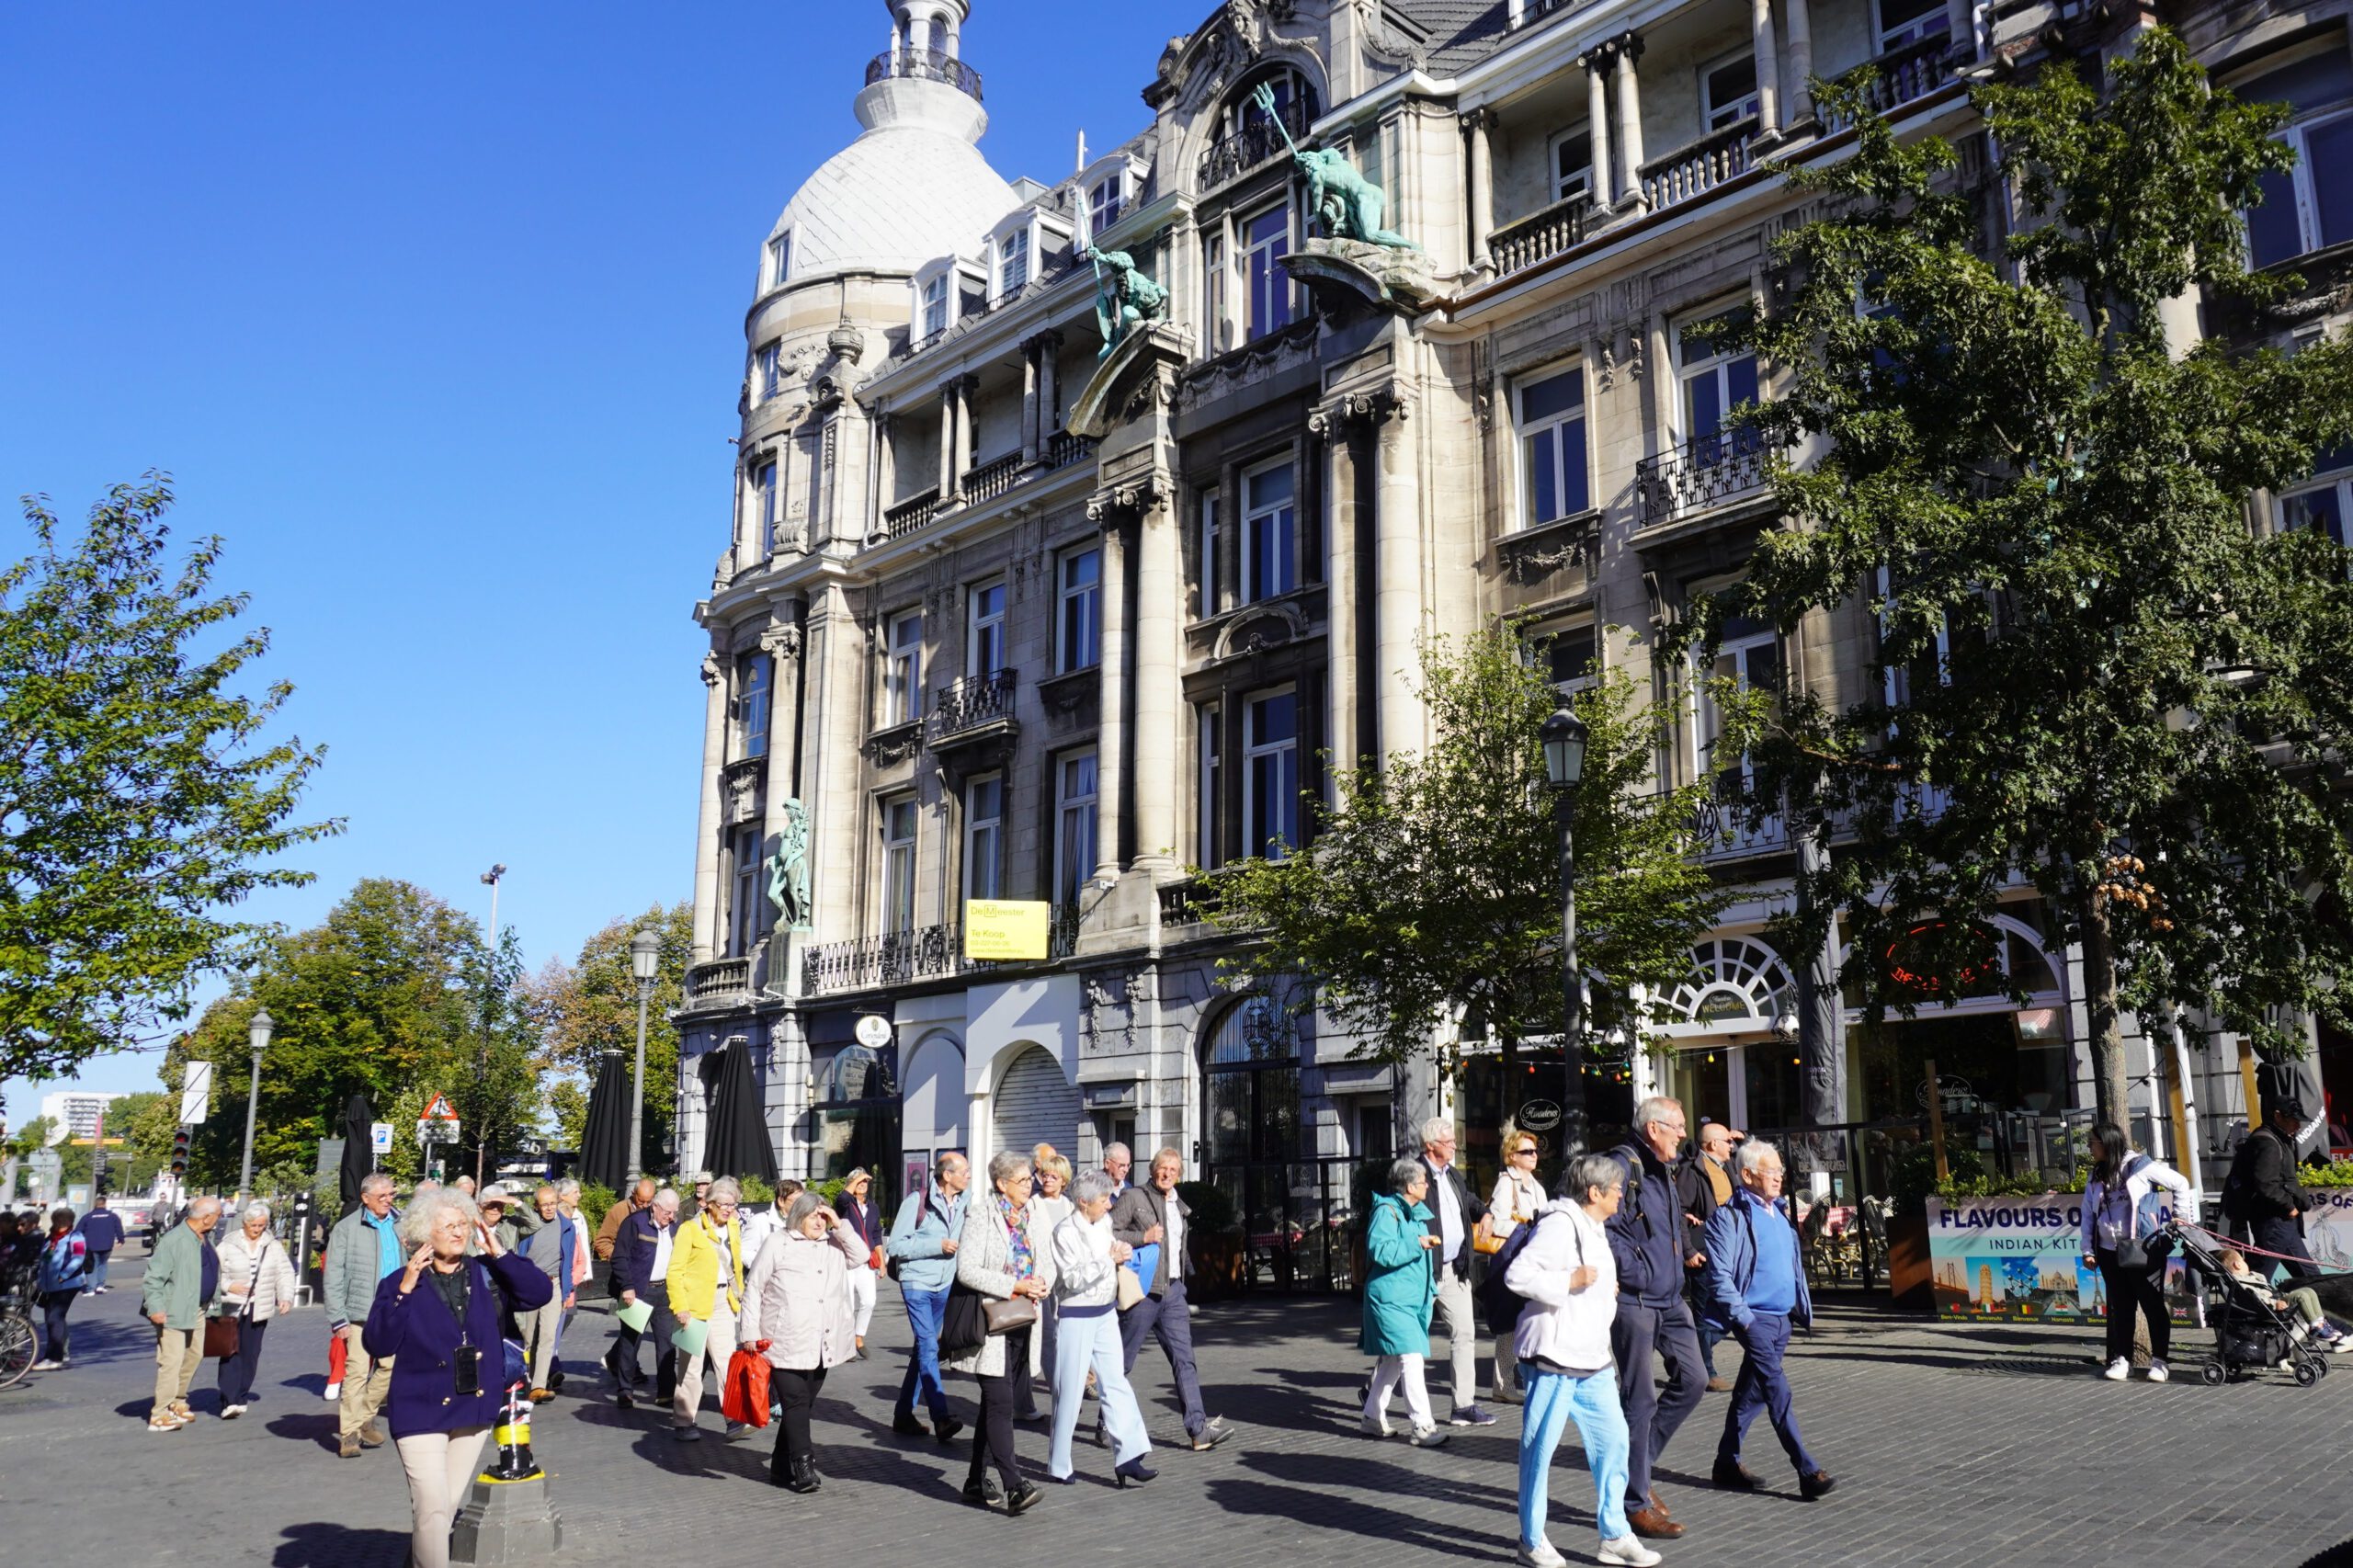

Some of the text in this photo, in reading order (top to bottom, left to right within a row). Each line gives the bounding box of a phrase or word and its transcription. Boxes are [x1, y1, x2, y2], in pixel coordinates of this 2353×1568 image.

[971, 929, 1006, 938] Te Koop
[1702, 1001, 1745, 1014] WELCOME
[1522, 1105, 1559, 1119] Amadeus
[2295, 1115, 2322, 1144] INDIAN
[1939, 1207, 2063, 1228] FLAVOURS
[2067, 1207, 2082, 1227] O
[1989, 1239, 2043, 1250] INDIAN
